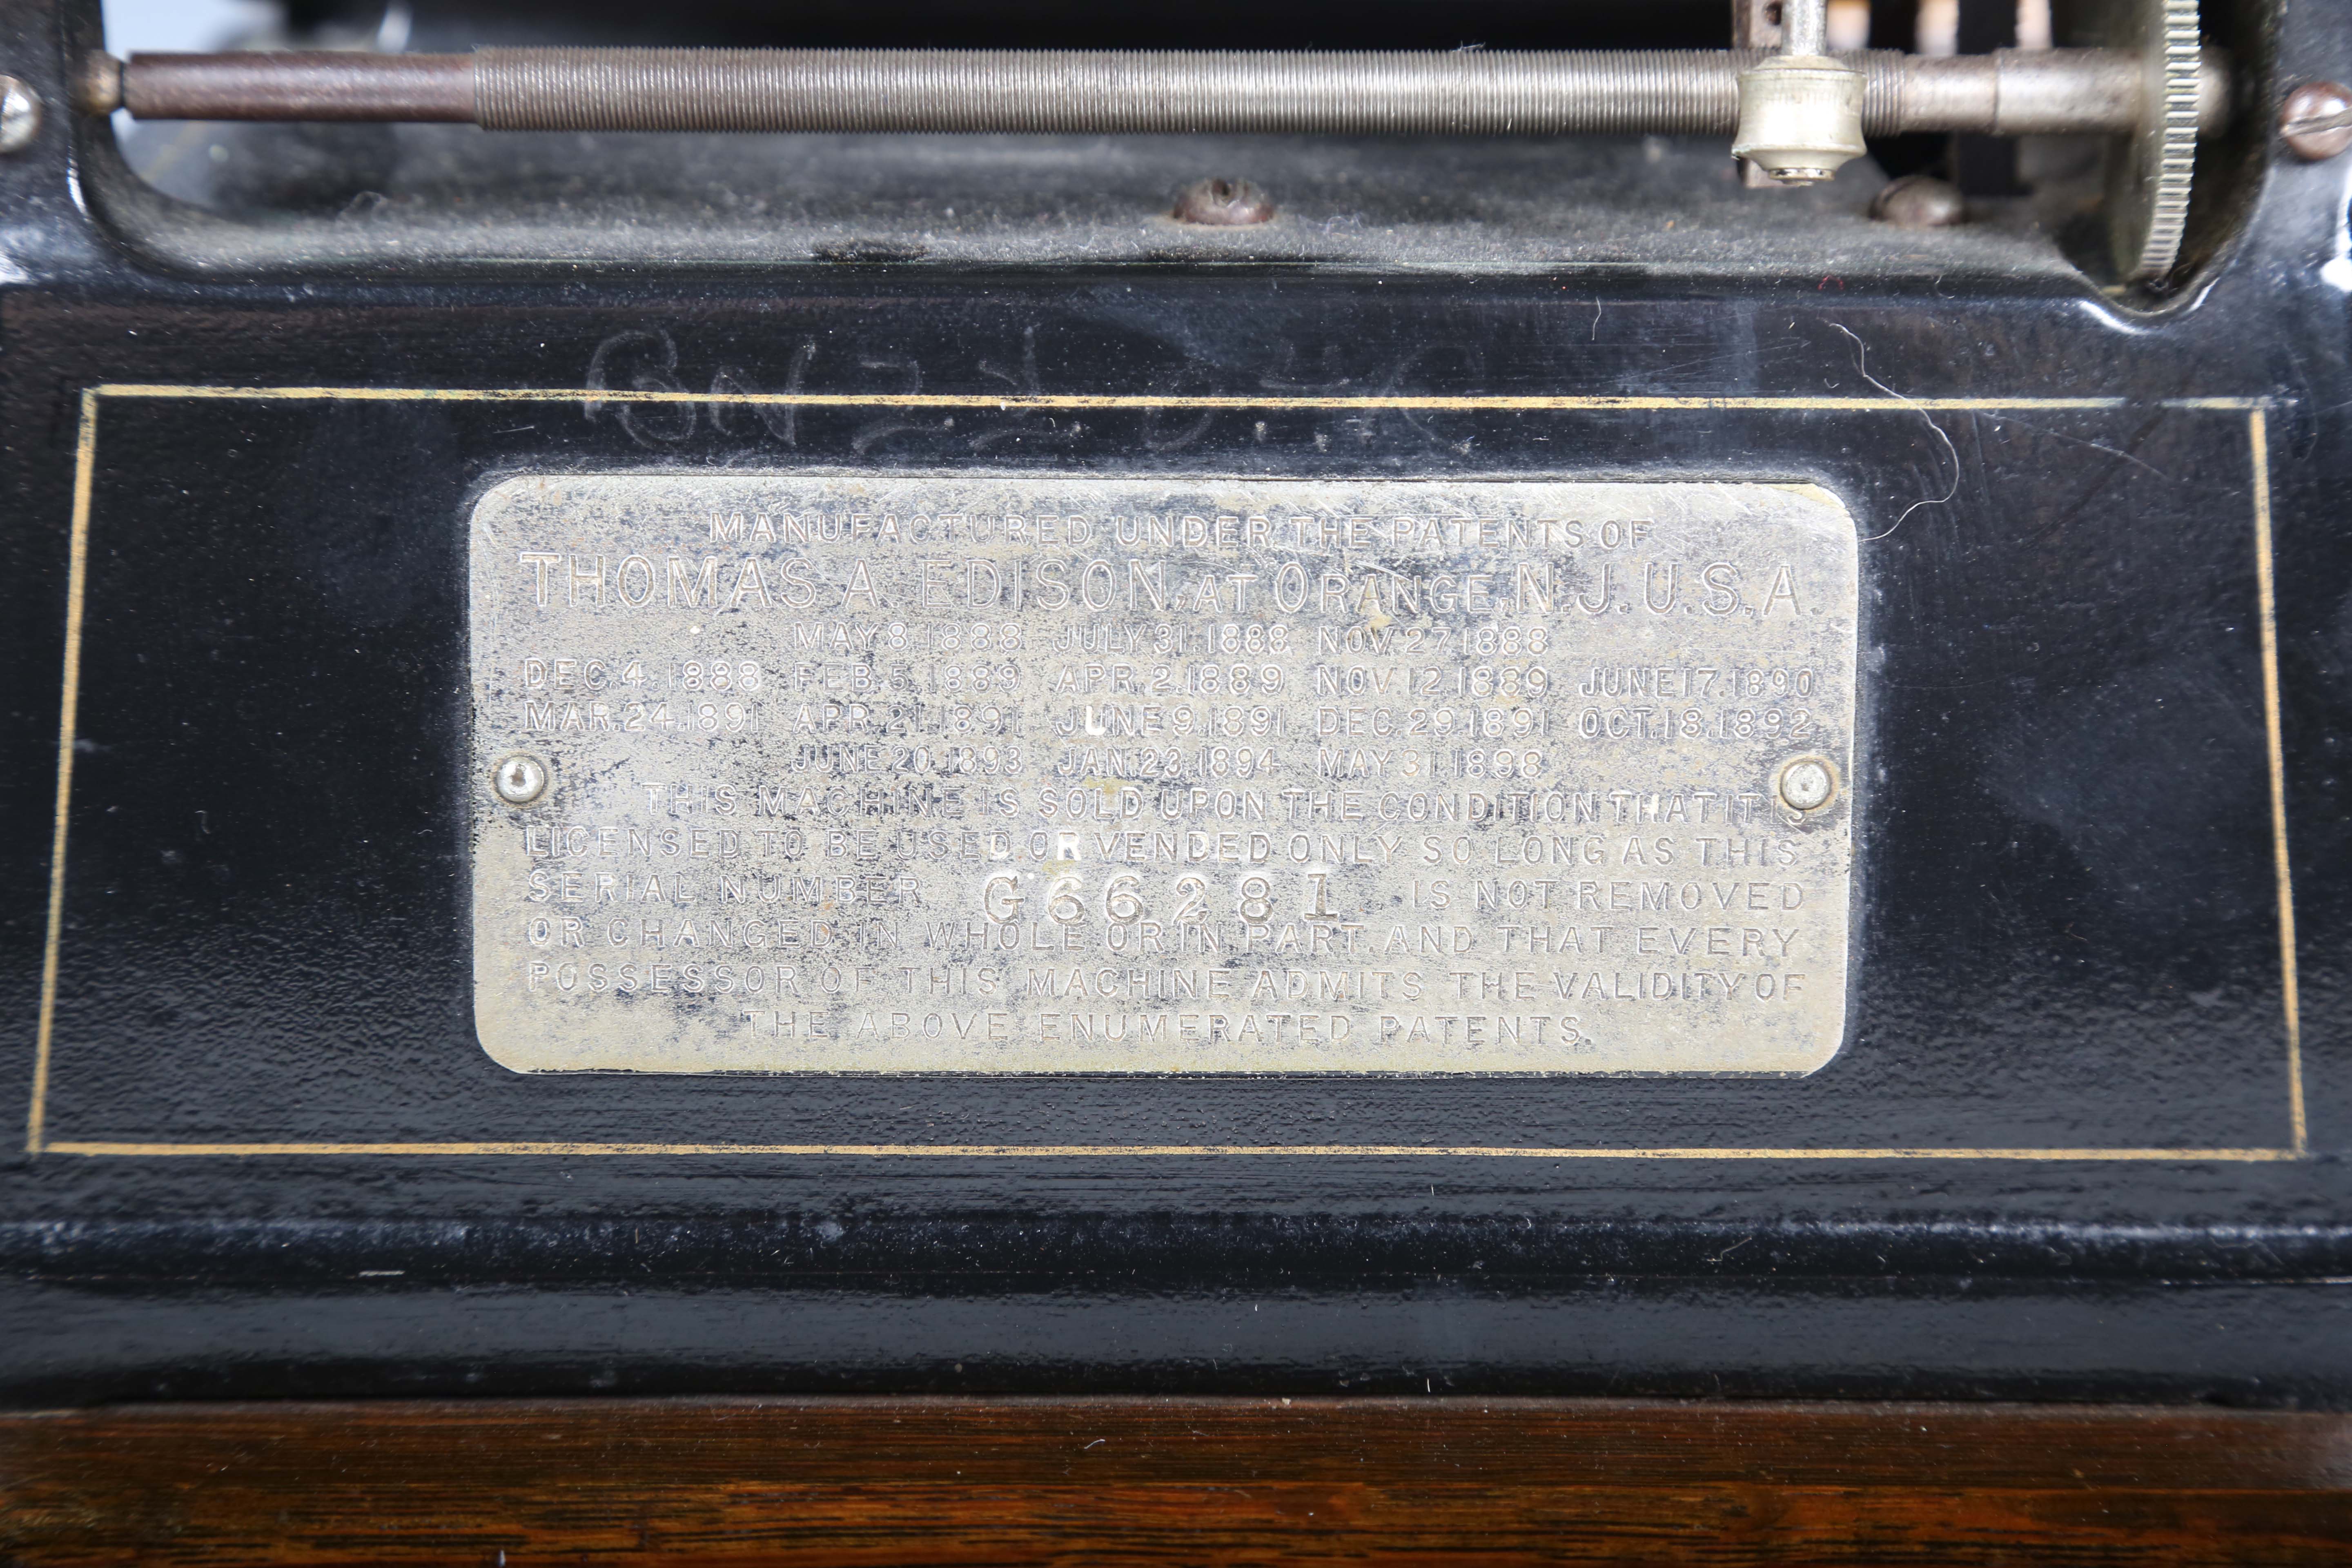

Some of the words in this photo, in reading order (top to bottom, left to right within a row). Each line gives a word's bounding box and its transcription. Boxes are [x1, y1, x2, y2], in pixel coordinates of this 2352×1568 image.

[709, 512, 1092, 545] MANUFACTURED
[1116, 514, 1271, 548] UNDER
[1290, 516, 1372, 549] THE
[1392, 517, 1585, 549] PATENTS
[1599, 519, 1653, 550] OF
[519, 551, 816, 608] THOMAS
[922, 558, 1186, 612] EDISON,
[1193, 574, 1258, 613] AT
[641, 782, 737, 816] THIS
[758, 785, 964, 817] MACHINE
[979, 788, 1020, 818] IS
[1038, 787, 1144, 820] SOLD
[1161, 787, 1267, 821] UPON
[1281, 788, 1363, 822] THE
[1378, 791, 1599, 823] CONDITION
[1609, 790, 1717, 824] THAT
[1725, 791, 1762, 824] IT
[524, 825, 740, 858] LICENSED
[755, 829, 804, 858] TO
[827, 830, 877, 859] BE
[897, 831, 1012, 860] USED
[1029, 831, 1082, 861] OR
[1094, 831, 1271, 862] VENDED
[1288, 834, 1403, 864] ONLY
[1423, 835, 1473, 864] SO
[1495, 836, 1605, 866] LONG
[1621, 836, 1675, 866] AS
[1695, 837, 1797, 867] THIS
[528, 870, 696, 903] SERIAL
[720, 875, 922, 904] NUMBER
[983, 871, 1339, 925] G66281
[1413, 880, 1450, 909] IS
[1475, 880, 1559, 910] NOT
[1578, 881, 1804, 911] REMOVED
[528, 916, 586, 948] OR
[607, 917, 834, 949] CHANGED
[858, 920, 899, 949] IN
[925, 921, 1087, 951] WHOLE
[1107, 922, 1165, 952] OR
[1180, 922, 1224, 953] IN
[1385, 925, 1474, 954] AND
[1496, 926, 1613, 954] THAT
[1637, 927, 1800, 957] EVERY
[528, 961, 799, 993] POSSESSOR
[820, 966, 877, 994] OF
[898, 967, 999, 995] THIS
[1027, 969, 1230, 999] MACHINE
[1252, 970, 1423, 1001] ADMITS
[1449, 971, 1535, 1001] THE
[1552, 971, 1747, 1001] VALIDITY
[1755, 973, 1806, 1002] OF
[740, 1010, 829, 1040] THE
[857, 1012, 1009, 1040] ABOVE
[1039, 1013, 1352, 1044] ENUMERATED
[1378, 1016, 1592, 1047] PATENTS.
